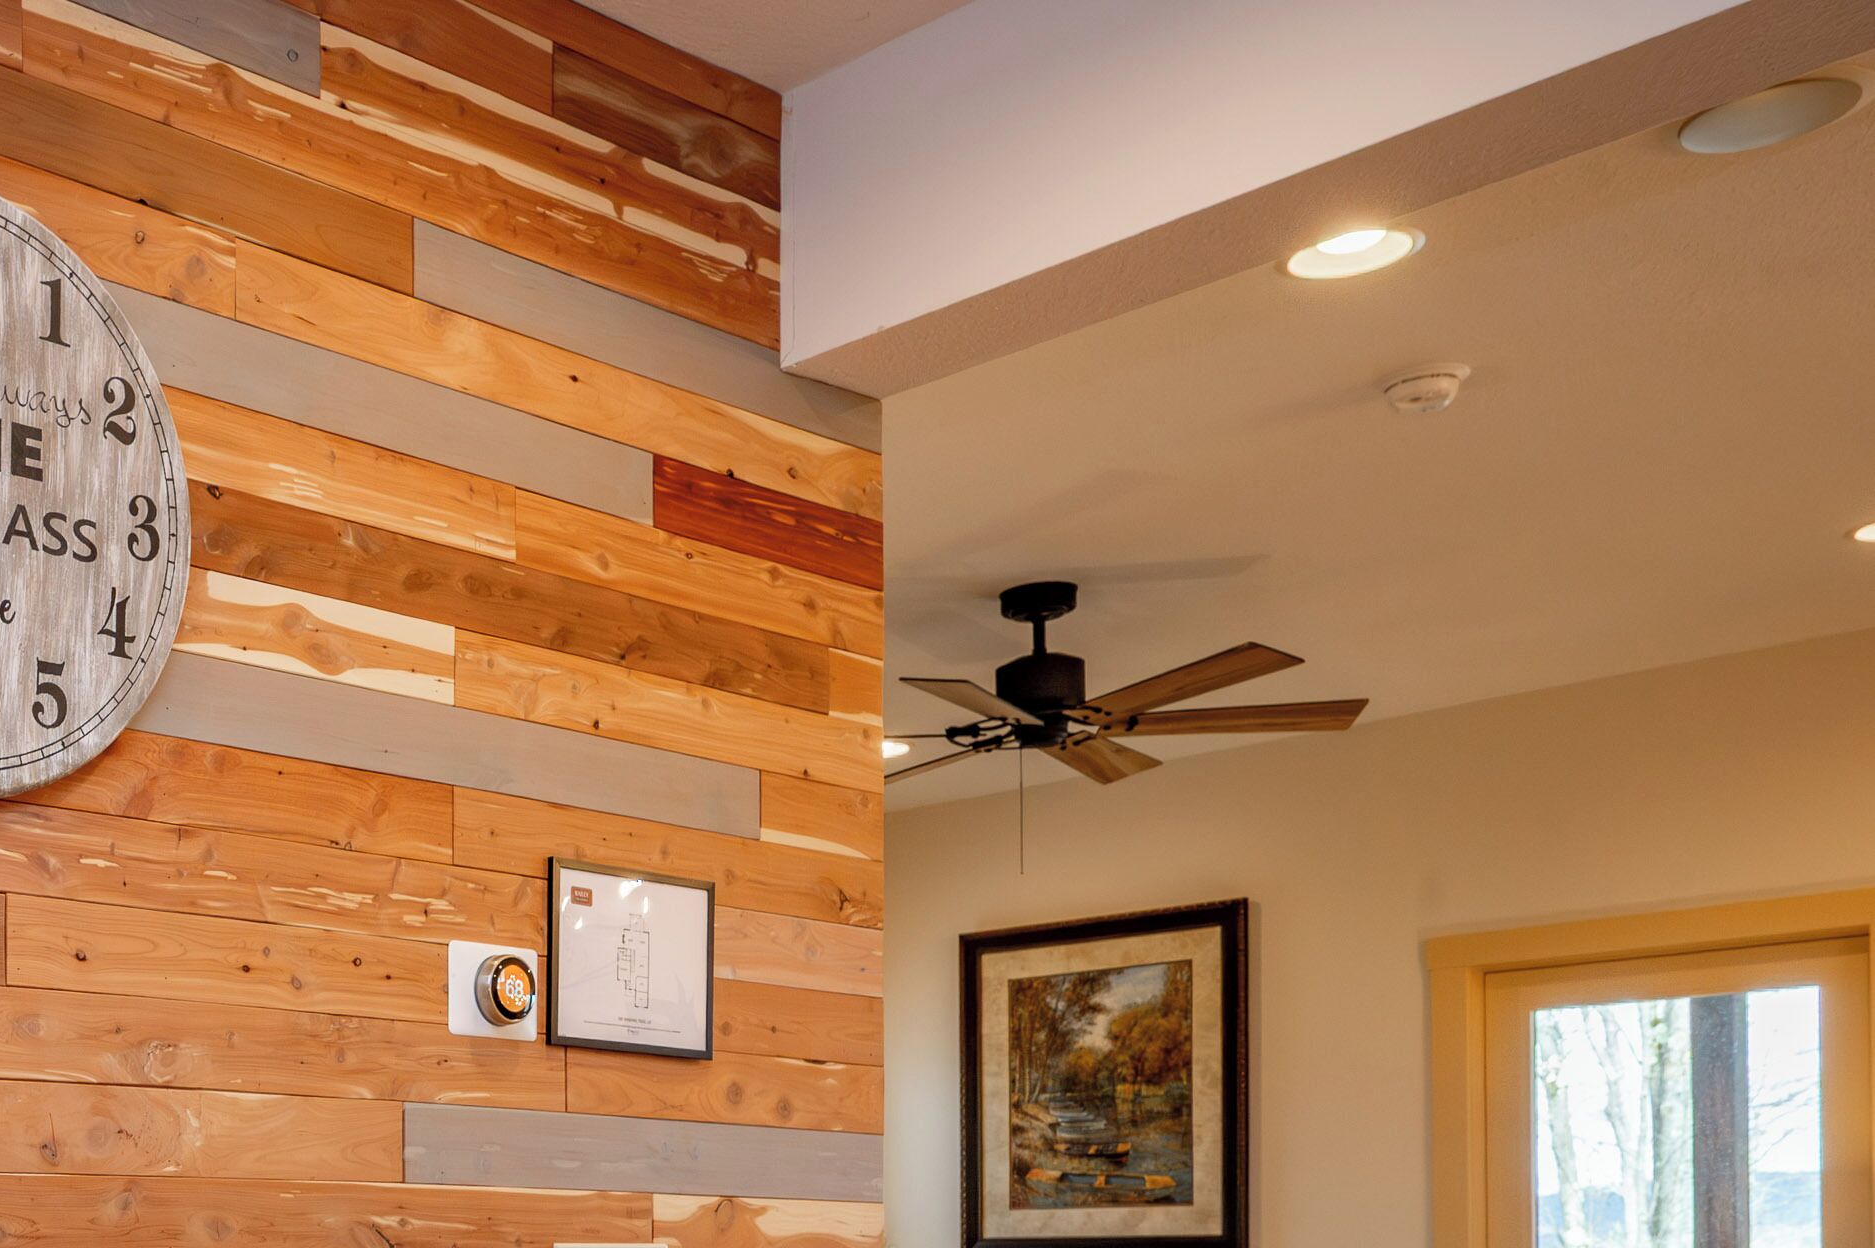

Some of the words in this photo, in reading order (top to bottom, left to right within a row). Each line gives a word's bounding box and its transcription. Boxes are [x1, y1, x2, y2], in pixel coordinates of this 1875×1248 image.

[38, 279, 71, 348] 1
[103, 376, 137, 447] 2
[127, 495, 160, 562] 3
[97, 587, 136, 660] 4
[32, 657, 67, 729] 5
[505, 979, 524, 998] 68
